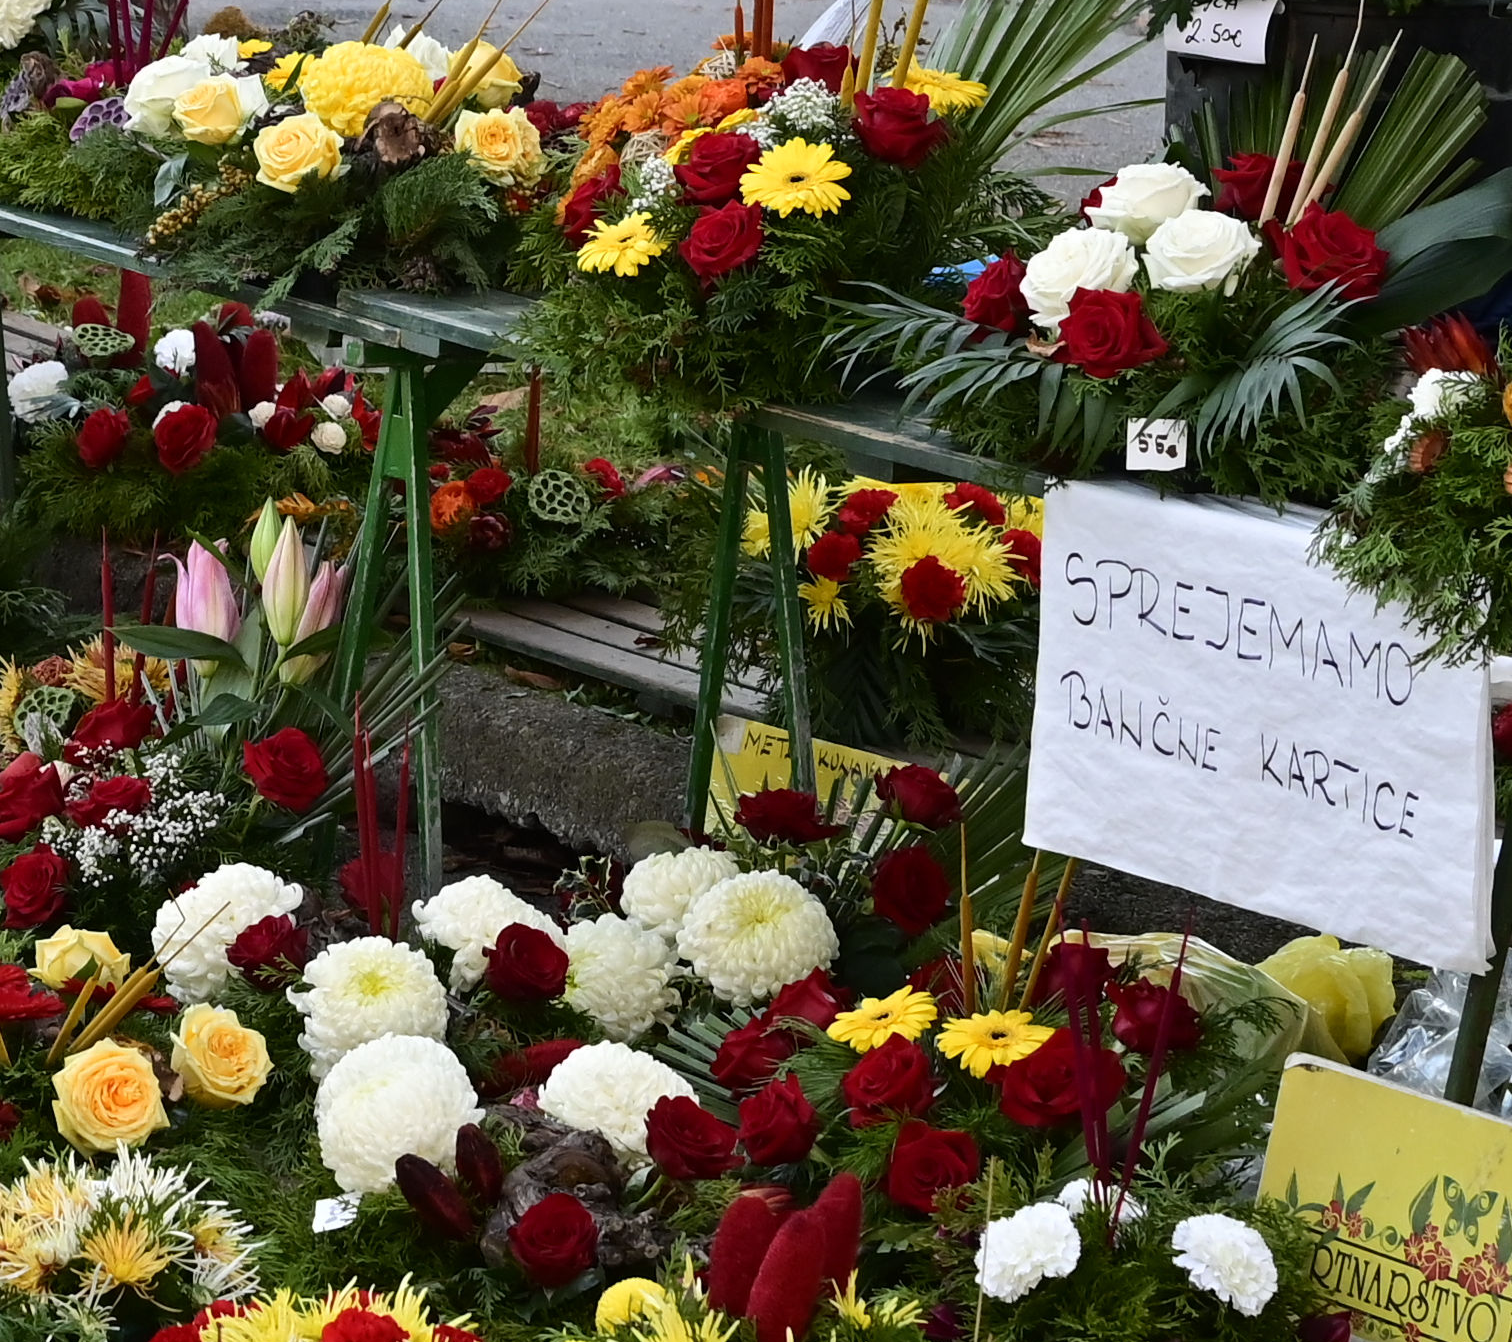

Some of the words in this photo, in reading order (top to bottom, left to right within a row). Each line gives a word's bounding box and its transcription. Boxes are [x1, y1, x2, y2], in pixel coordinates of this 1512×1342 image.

[1064, 551, 1415, 707] SPREJEMAMO
[1060, 670, 1222, 773] BANČNE
[1260, 733, 1420, 839] KARTICE
